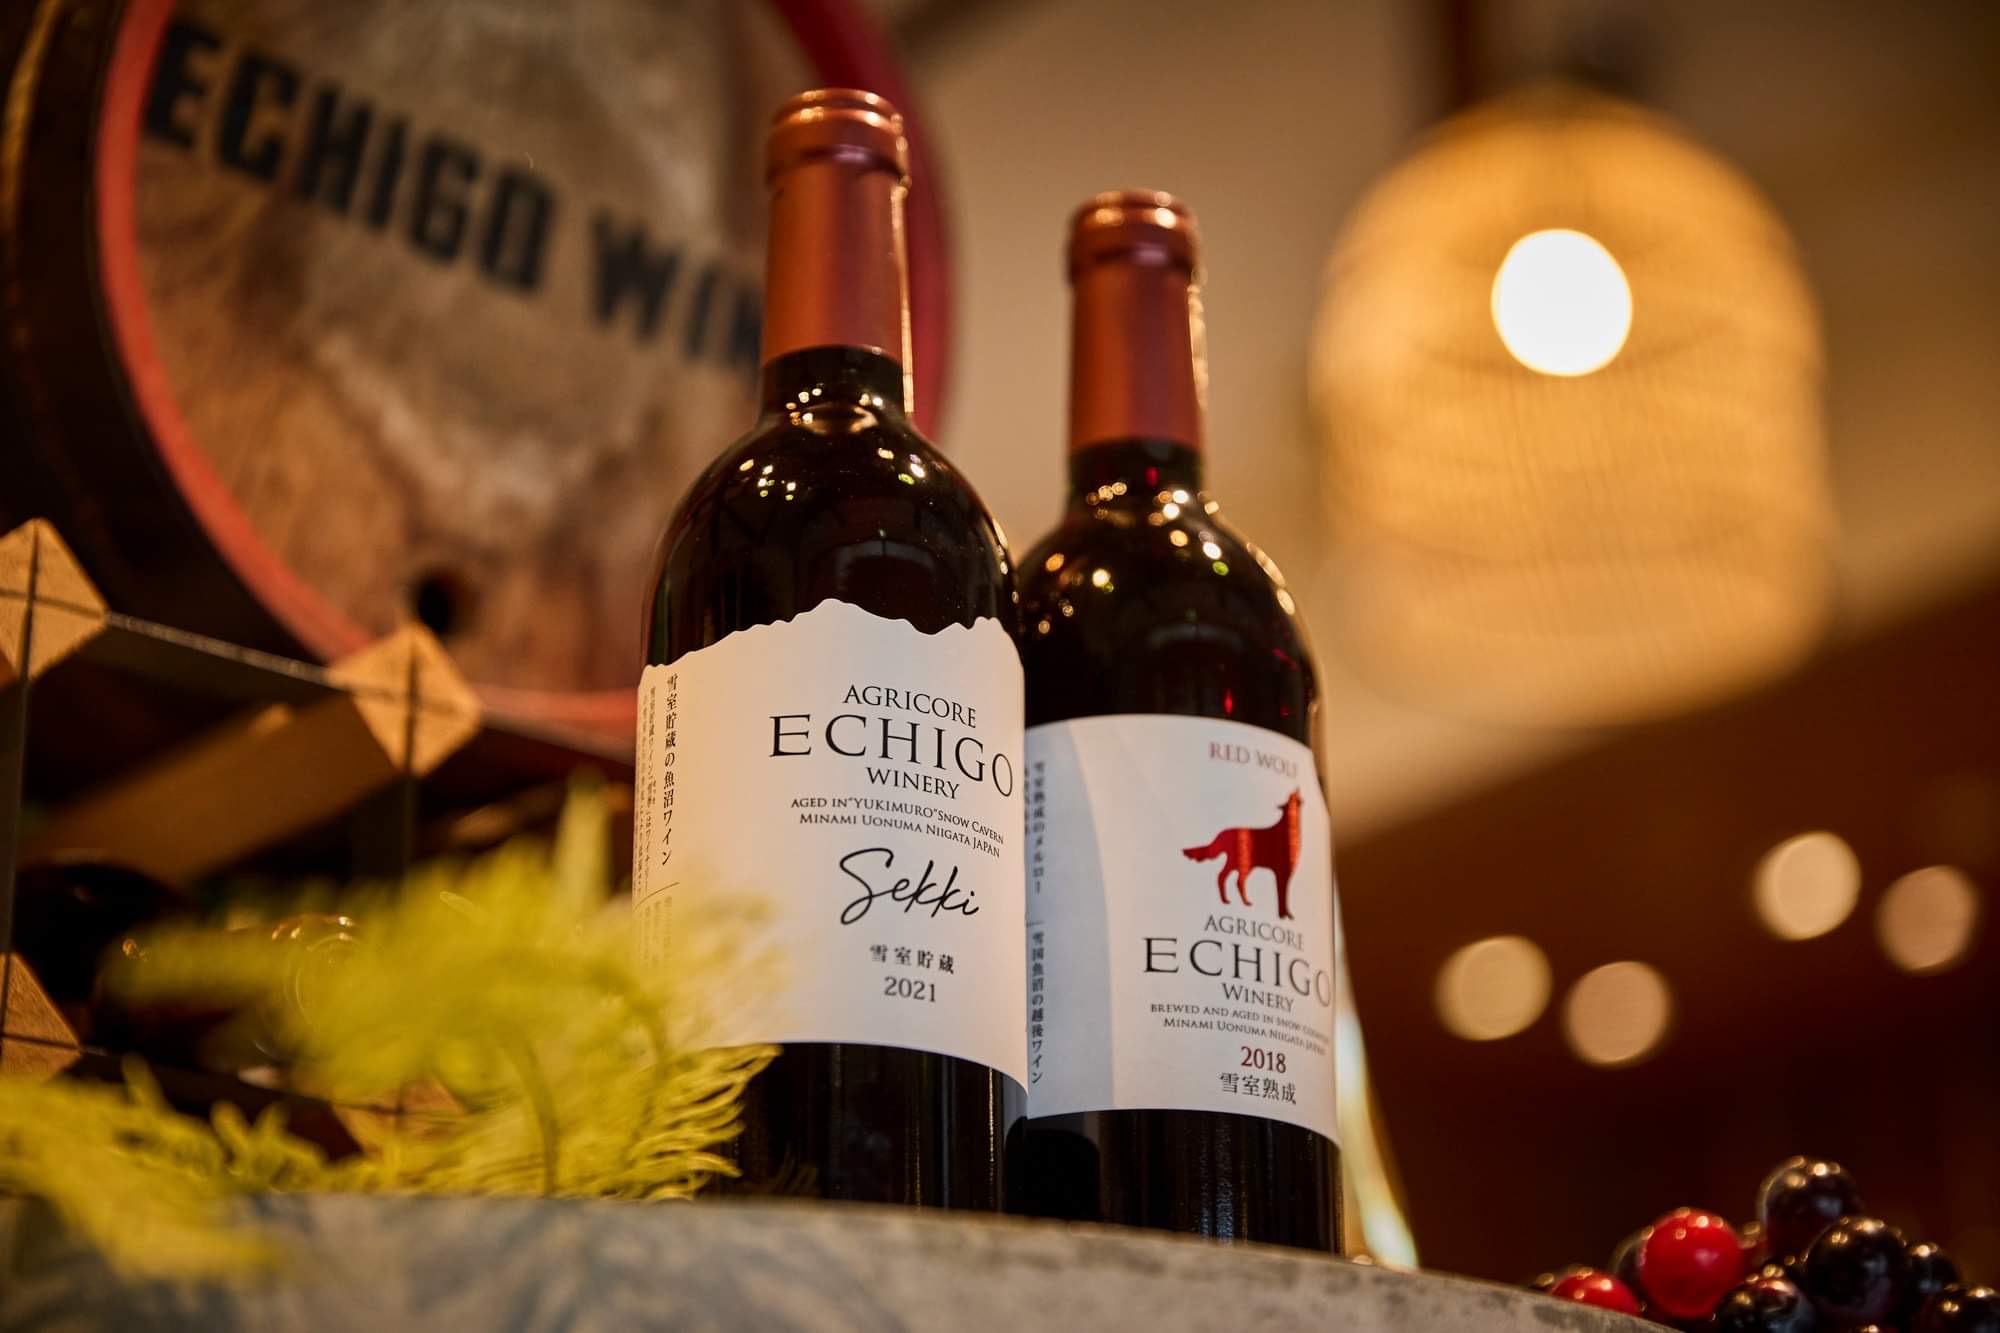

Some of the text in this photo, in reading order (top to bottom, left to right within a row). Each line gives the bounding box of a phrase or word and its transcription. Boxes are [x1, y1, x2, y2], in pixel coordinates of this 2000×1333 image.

[142, 18, 558, 296] ECHIGO
[842, 684, 977, 729] AGRICORE
[661, 673, 679, 866] 雪室貯蔵の魚沼ワイン
[768, 713, 1014, 798] ECHIGO
[1208, 741, 1251, 764] RED
[865, 766, 960, 800] WINERY
[790, 797, 828, 809] AGED
[971, 820, 1005, 845] CAVERN
[799, 813, 1001, 858] MINAMI UONUMA NIIGATA JAPAN
[839, 847, 980, 926] Sekki
[1203, 914, 1305, 951] AGRICORE
[870, 944, 954, 974] 雪室貯蔵
[1143, 937, 1331, 1008] ECHIGO
[884, 976, 936, 1003] 2021
[1221, 982, 1295, 1013] WINERY
[1150, 1003, 1200, 1015] BREWED
[1203, 1006, 1230, 1017] AND
[1232, 1010, 1260, 1022] AGED
[1262, 1014, 1274, 1025] IN
[1163, 1018, 1214, 1030] MINAMI
[1217, 1020, 1267, 1039] UONUMA
[1269, 1029, 1304, 1048] NIIGATA
[1240, 1046, 1287, 1074] 2018
[1219, 1072, 1297, 1106] 雪室熟成
